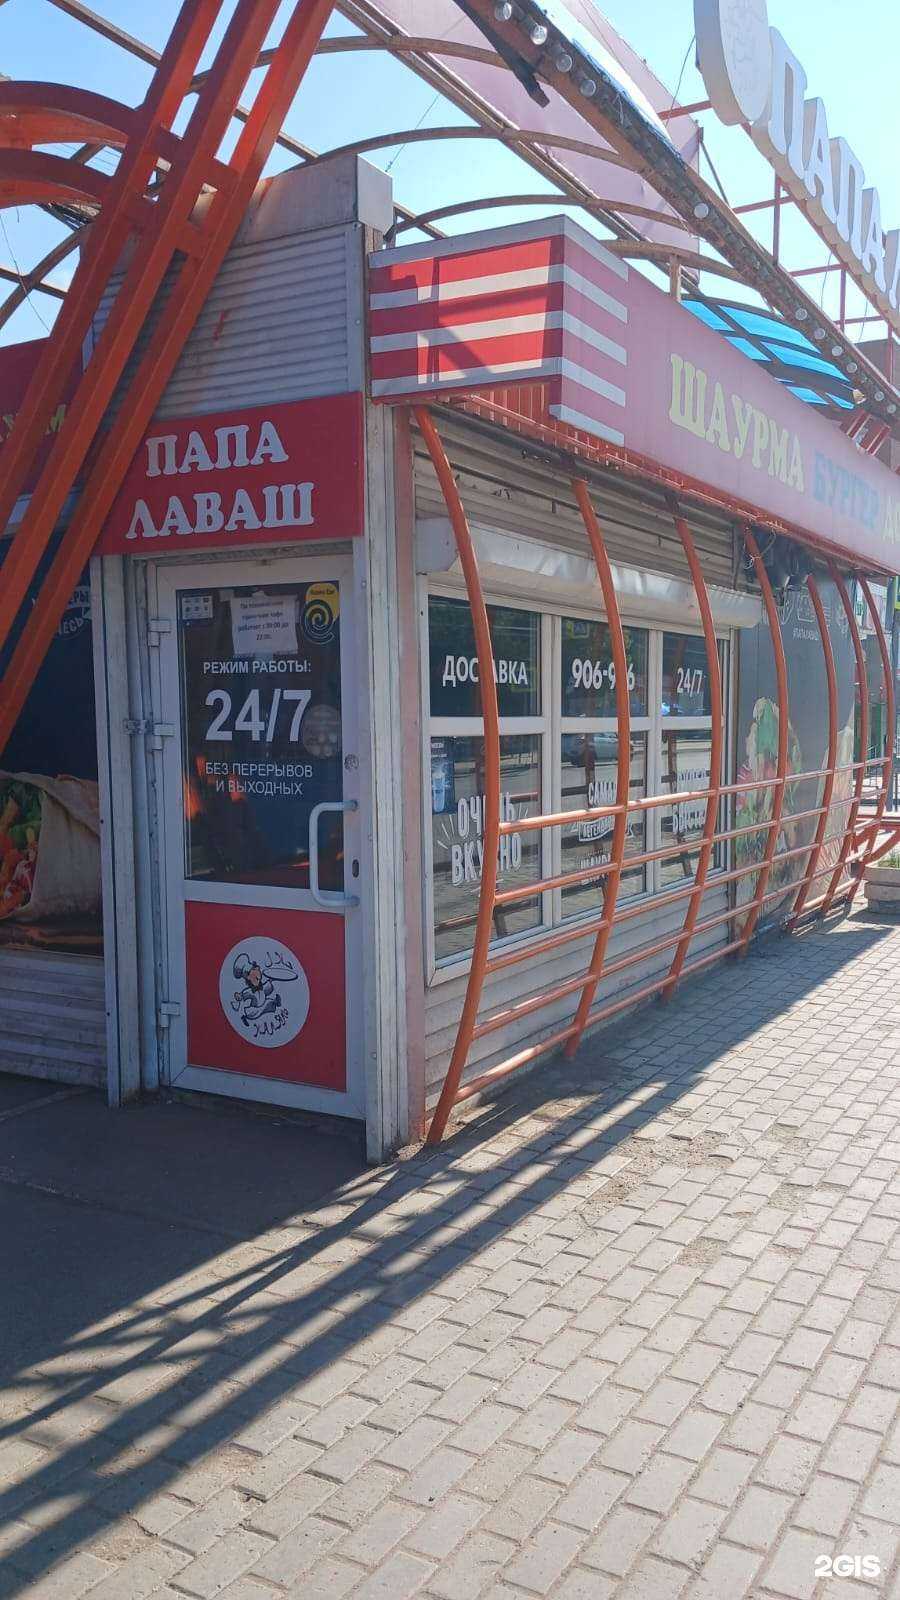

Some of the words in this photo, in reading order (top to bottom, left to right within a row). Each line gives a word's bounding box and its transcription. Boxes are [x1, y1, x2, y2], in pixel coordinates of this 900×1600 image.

[669, 353, 804, 494] ШАУРМА
[145, 421, 289, 477] ПАПА
[126, 482, 314, 539] ЛАВАШ
[203, 661, 248, 673] РЕЖИМ
[252, 660, 312, 673] РАБОТЫ:
[442, 655, 529, 688] ДОСАВКА
[572, 658, 635, 691] 906-96
[676, 667, 703, 697] 24/7
[205, 688, 312, 742] 24/7
[205, 762, 229, 775] БЕЗ
[231, 763, 313, 778] ПЕРЕРЫВОВ
[215, 781, 225, 793] И
[228, 781, 303, 796] ВЫХОДНЫХ
